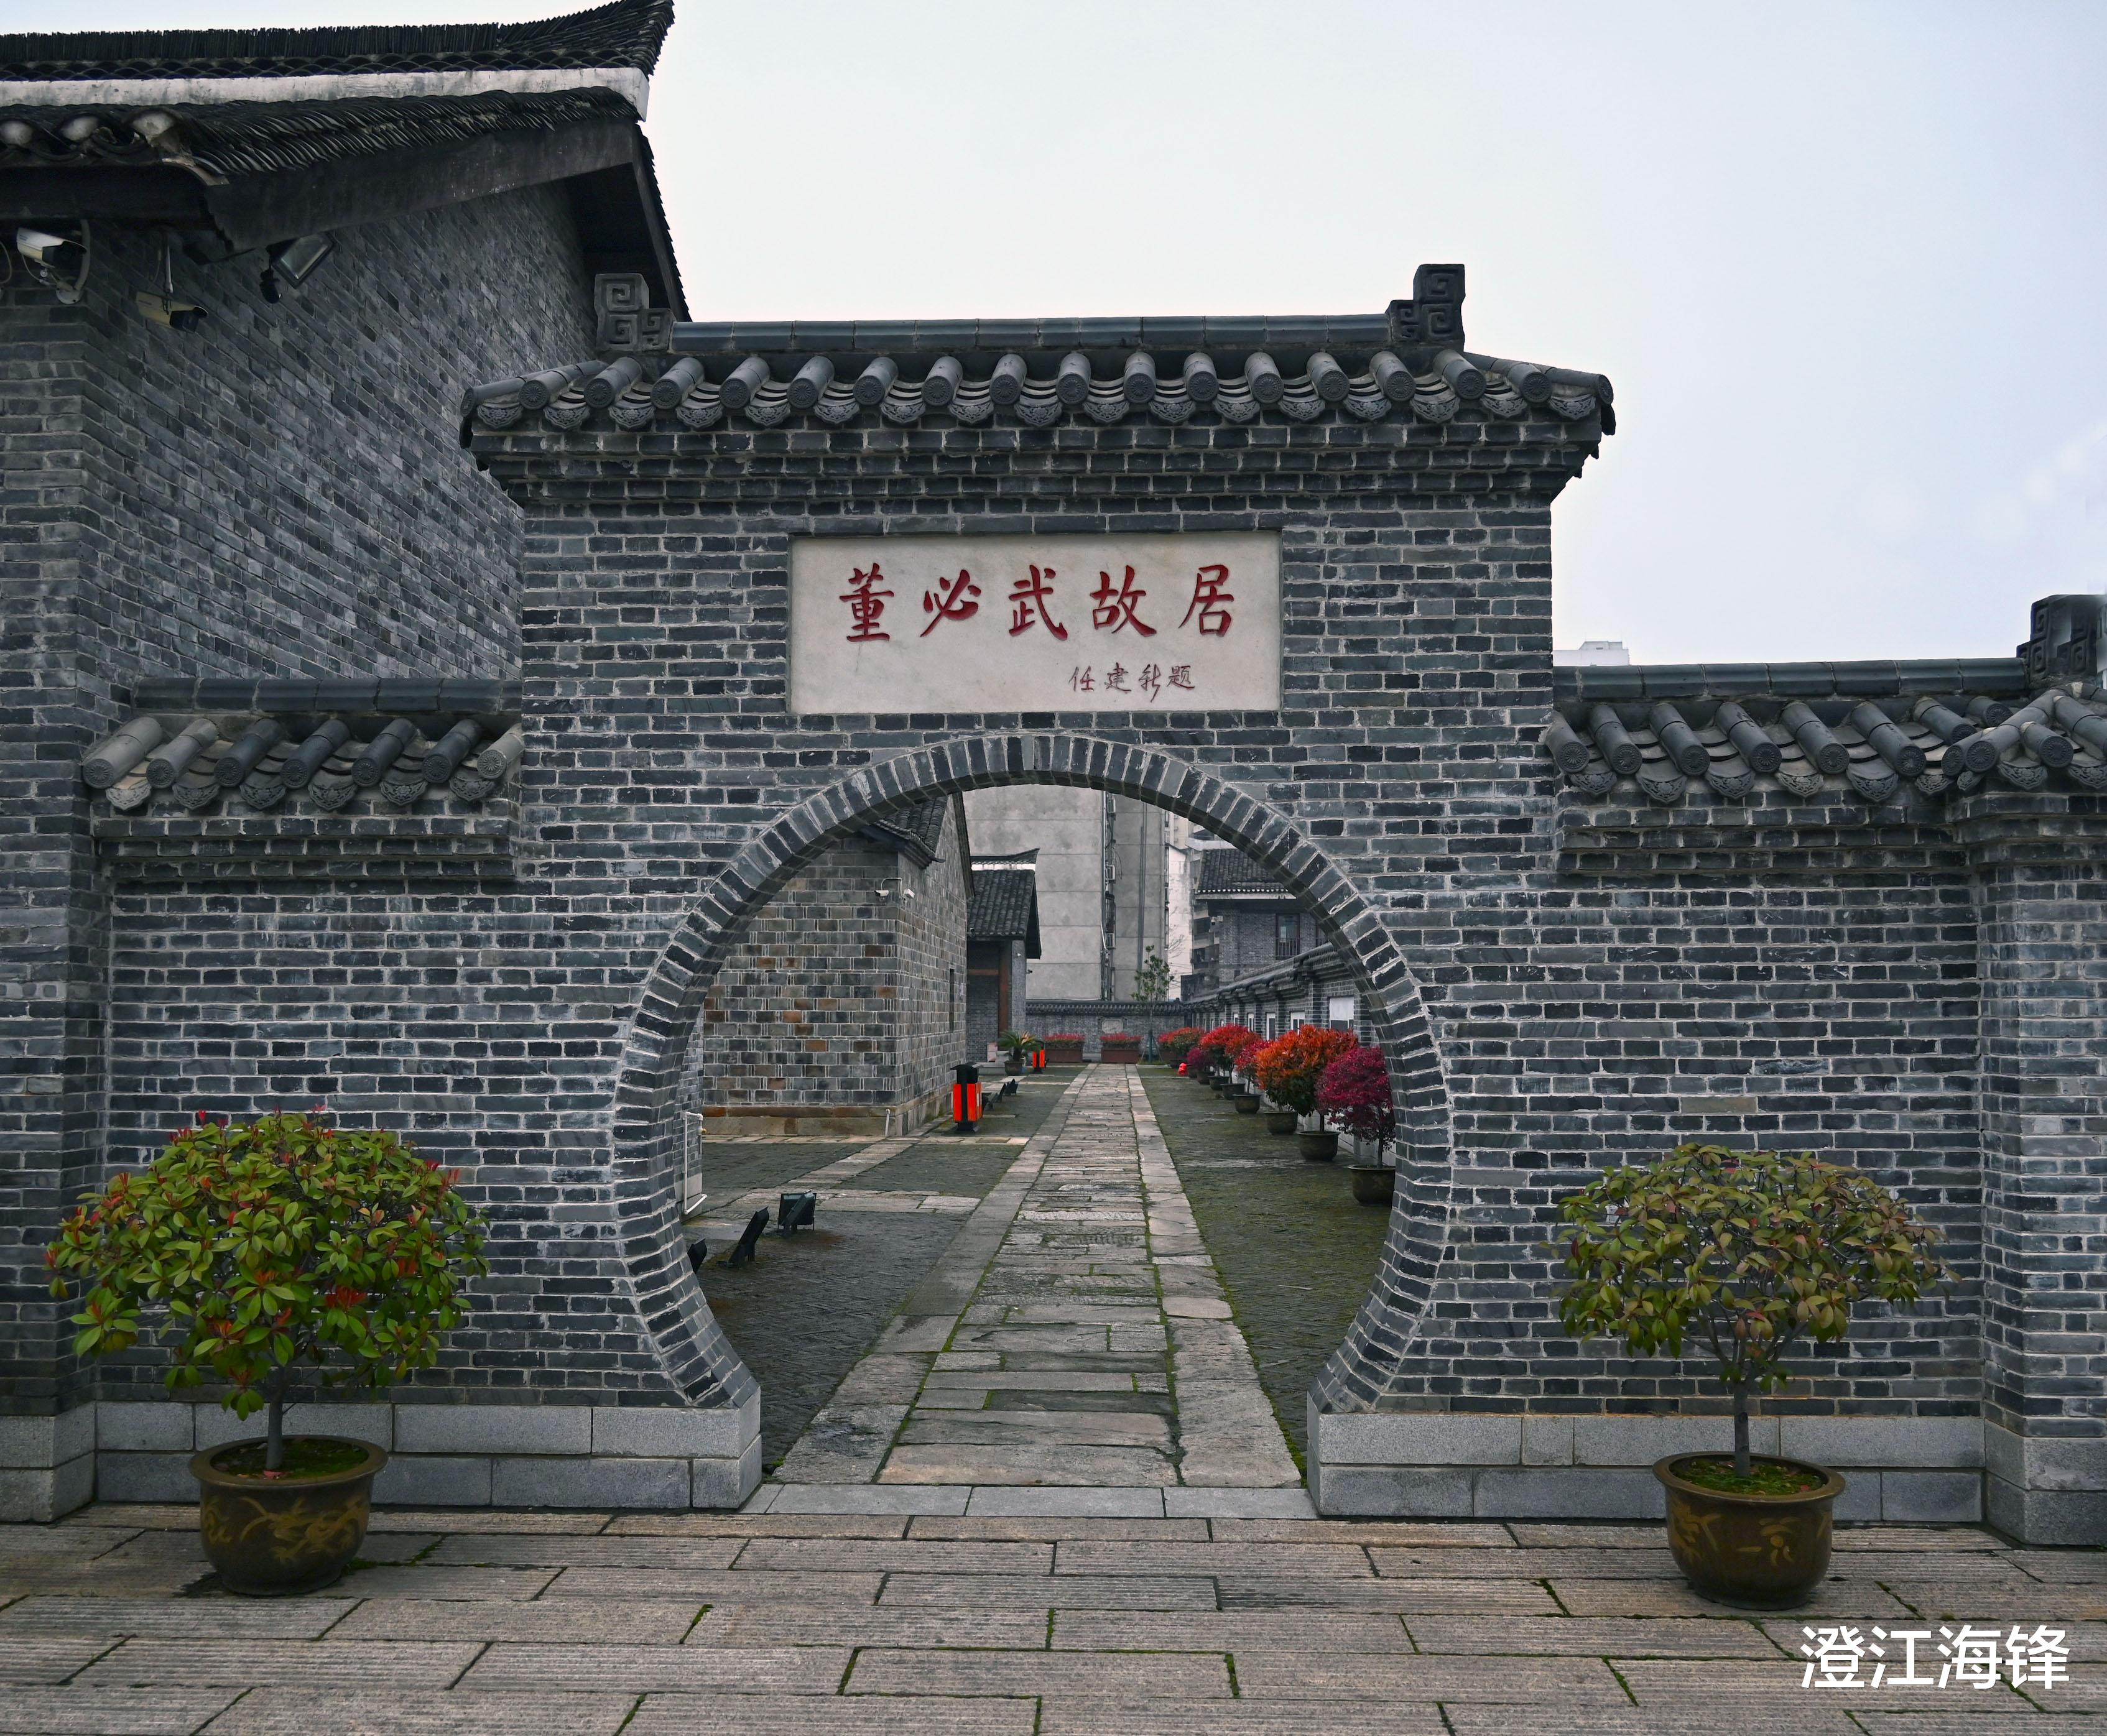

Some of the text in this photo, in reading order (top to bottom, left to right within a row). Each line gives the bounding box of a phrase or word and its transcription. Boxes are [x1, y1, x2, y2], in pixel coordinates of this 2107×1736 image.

[840, 563, 1234, 642] 董必武故居
